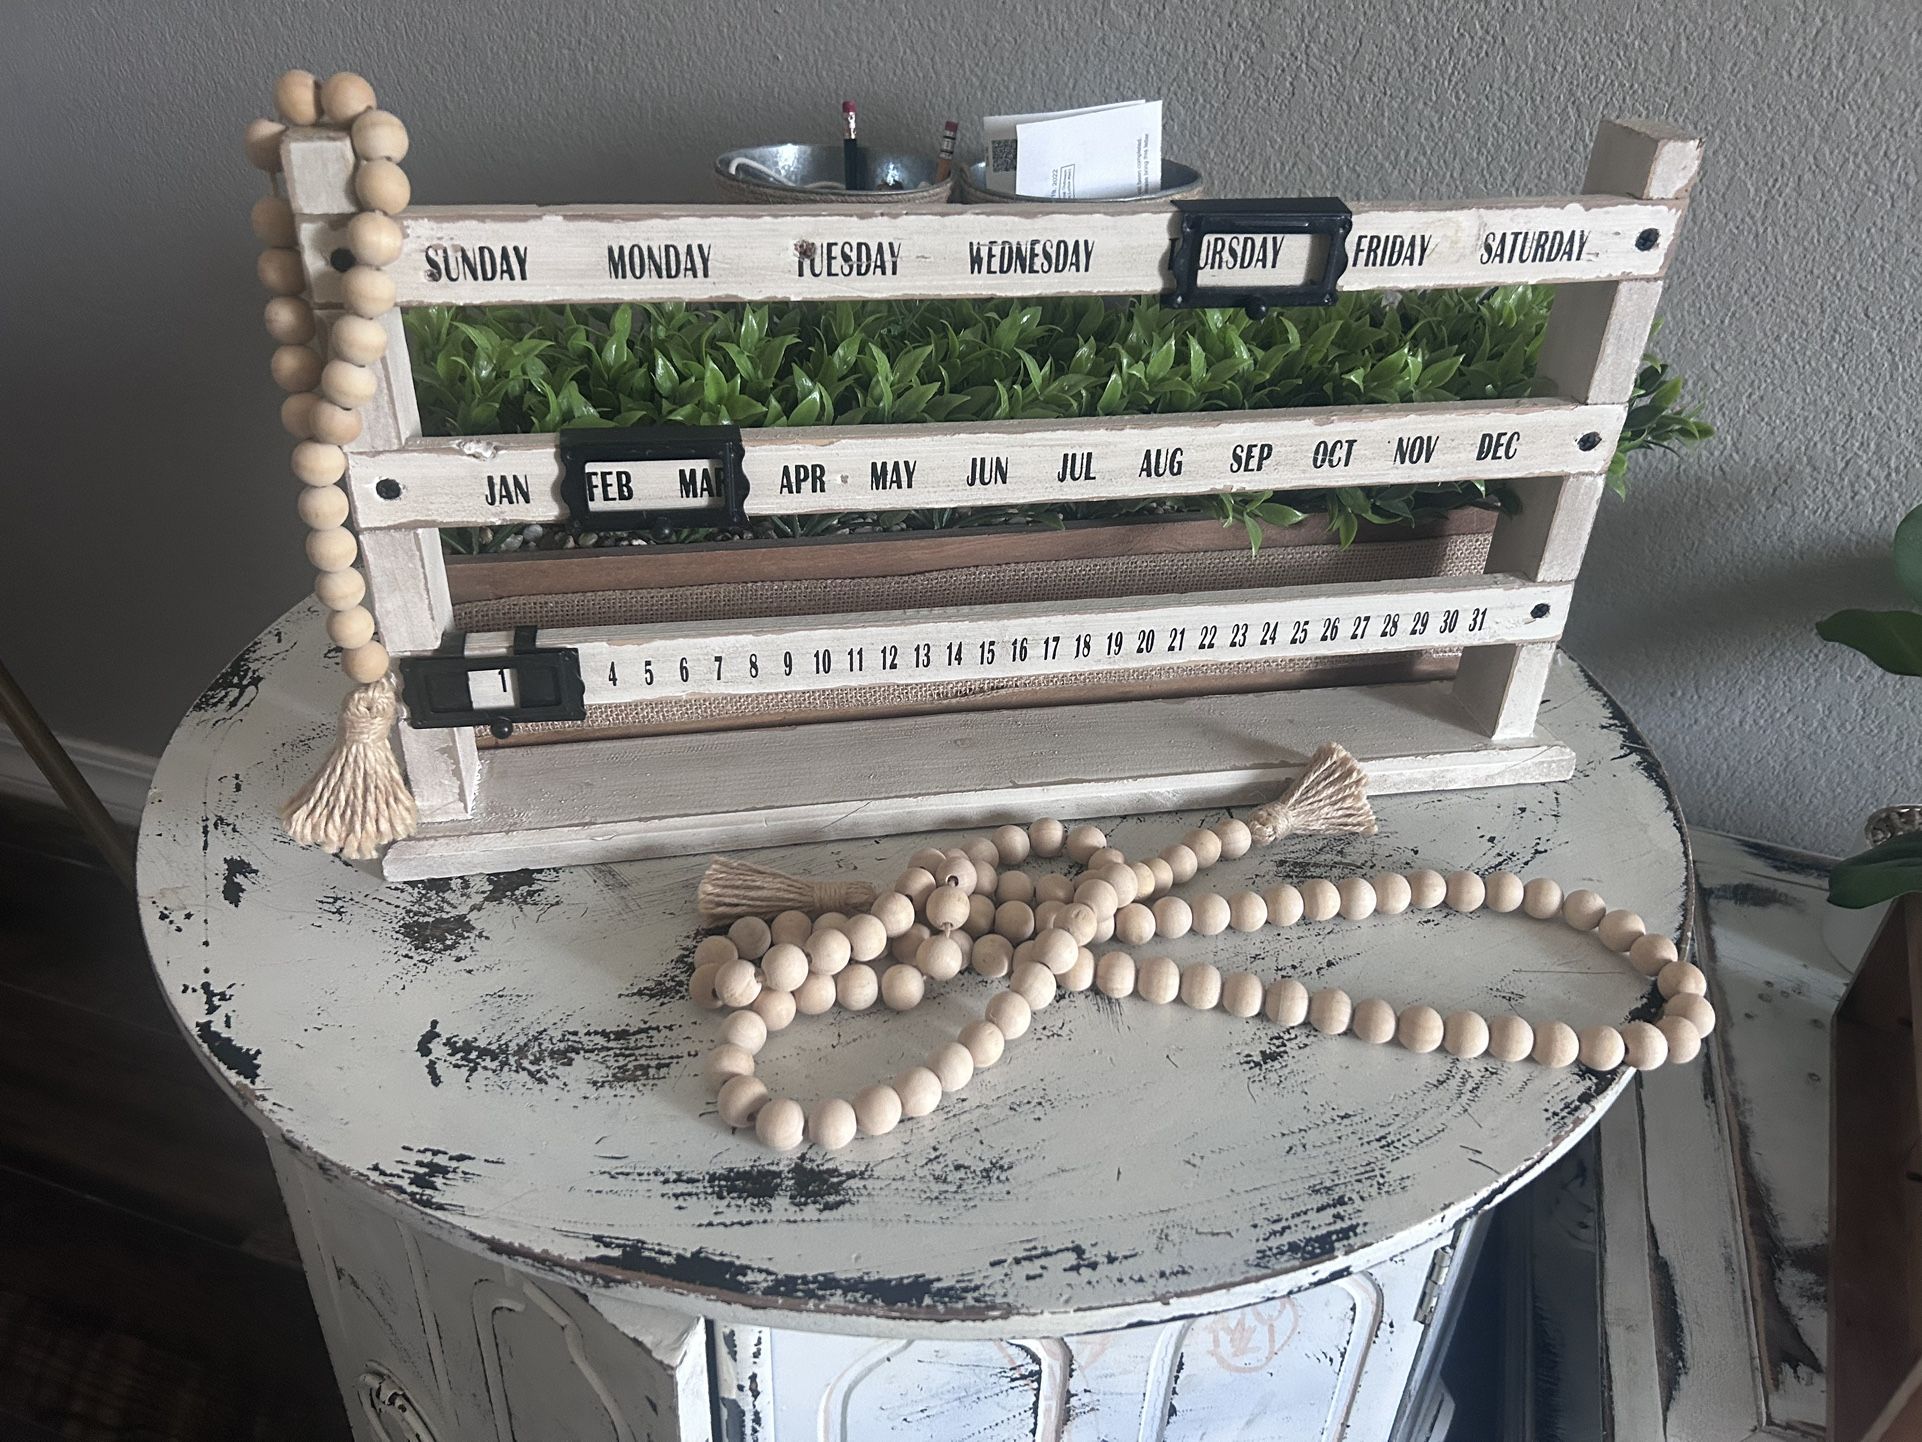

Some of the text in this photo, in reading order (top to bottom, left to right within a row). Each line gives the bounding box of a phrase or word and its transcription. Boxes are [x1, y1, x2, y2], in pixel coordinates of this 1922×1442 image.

[425, 245, 527, 282] SUNDAY
[608, 244, 711, 279] MONDAY
[969, 239, 1094, 274] WEDNESDAY
[1352, 233, 1432, 267] FRIDAY
[1480, 230, 1588, 264] SATURDAY
[485, 475, 530, 506] JAN
[586, 471, 633, 502] FEB
[780, 464, 825, 494] APR
[871, 460, 916, 490] MAY
[967, 457, 1008, 487] JUN
[1058, 452, 1096, 483] JUL
[1139, 448, 1183, 477] AUG
[1230, 444, 1273, 473] SEP
[1313, 439, 1357, 469] OCT
[1394, 436, 1439, 464] NOV
[1476, 432, 1520, 461] DEC
[498, 608, 1487, 692] 1 4 5 6 7 8 9 10 11 12 13 14 15 16 17 18 19 20 21 22 23 24 25 26 27 28 29 30 31
